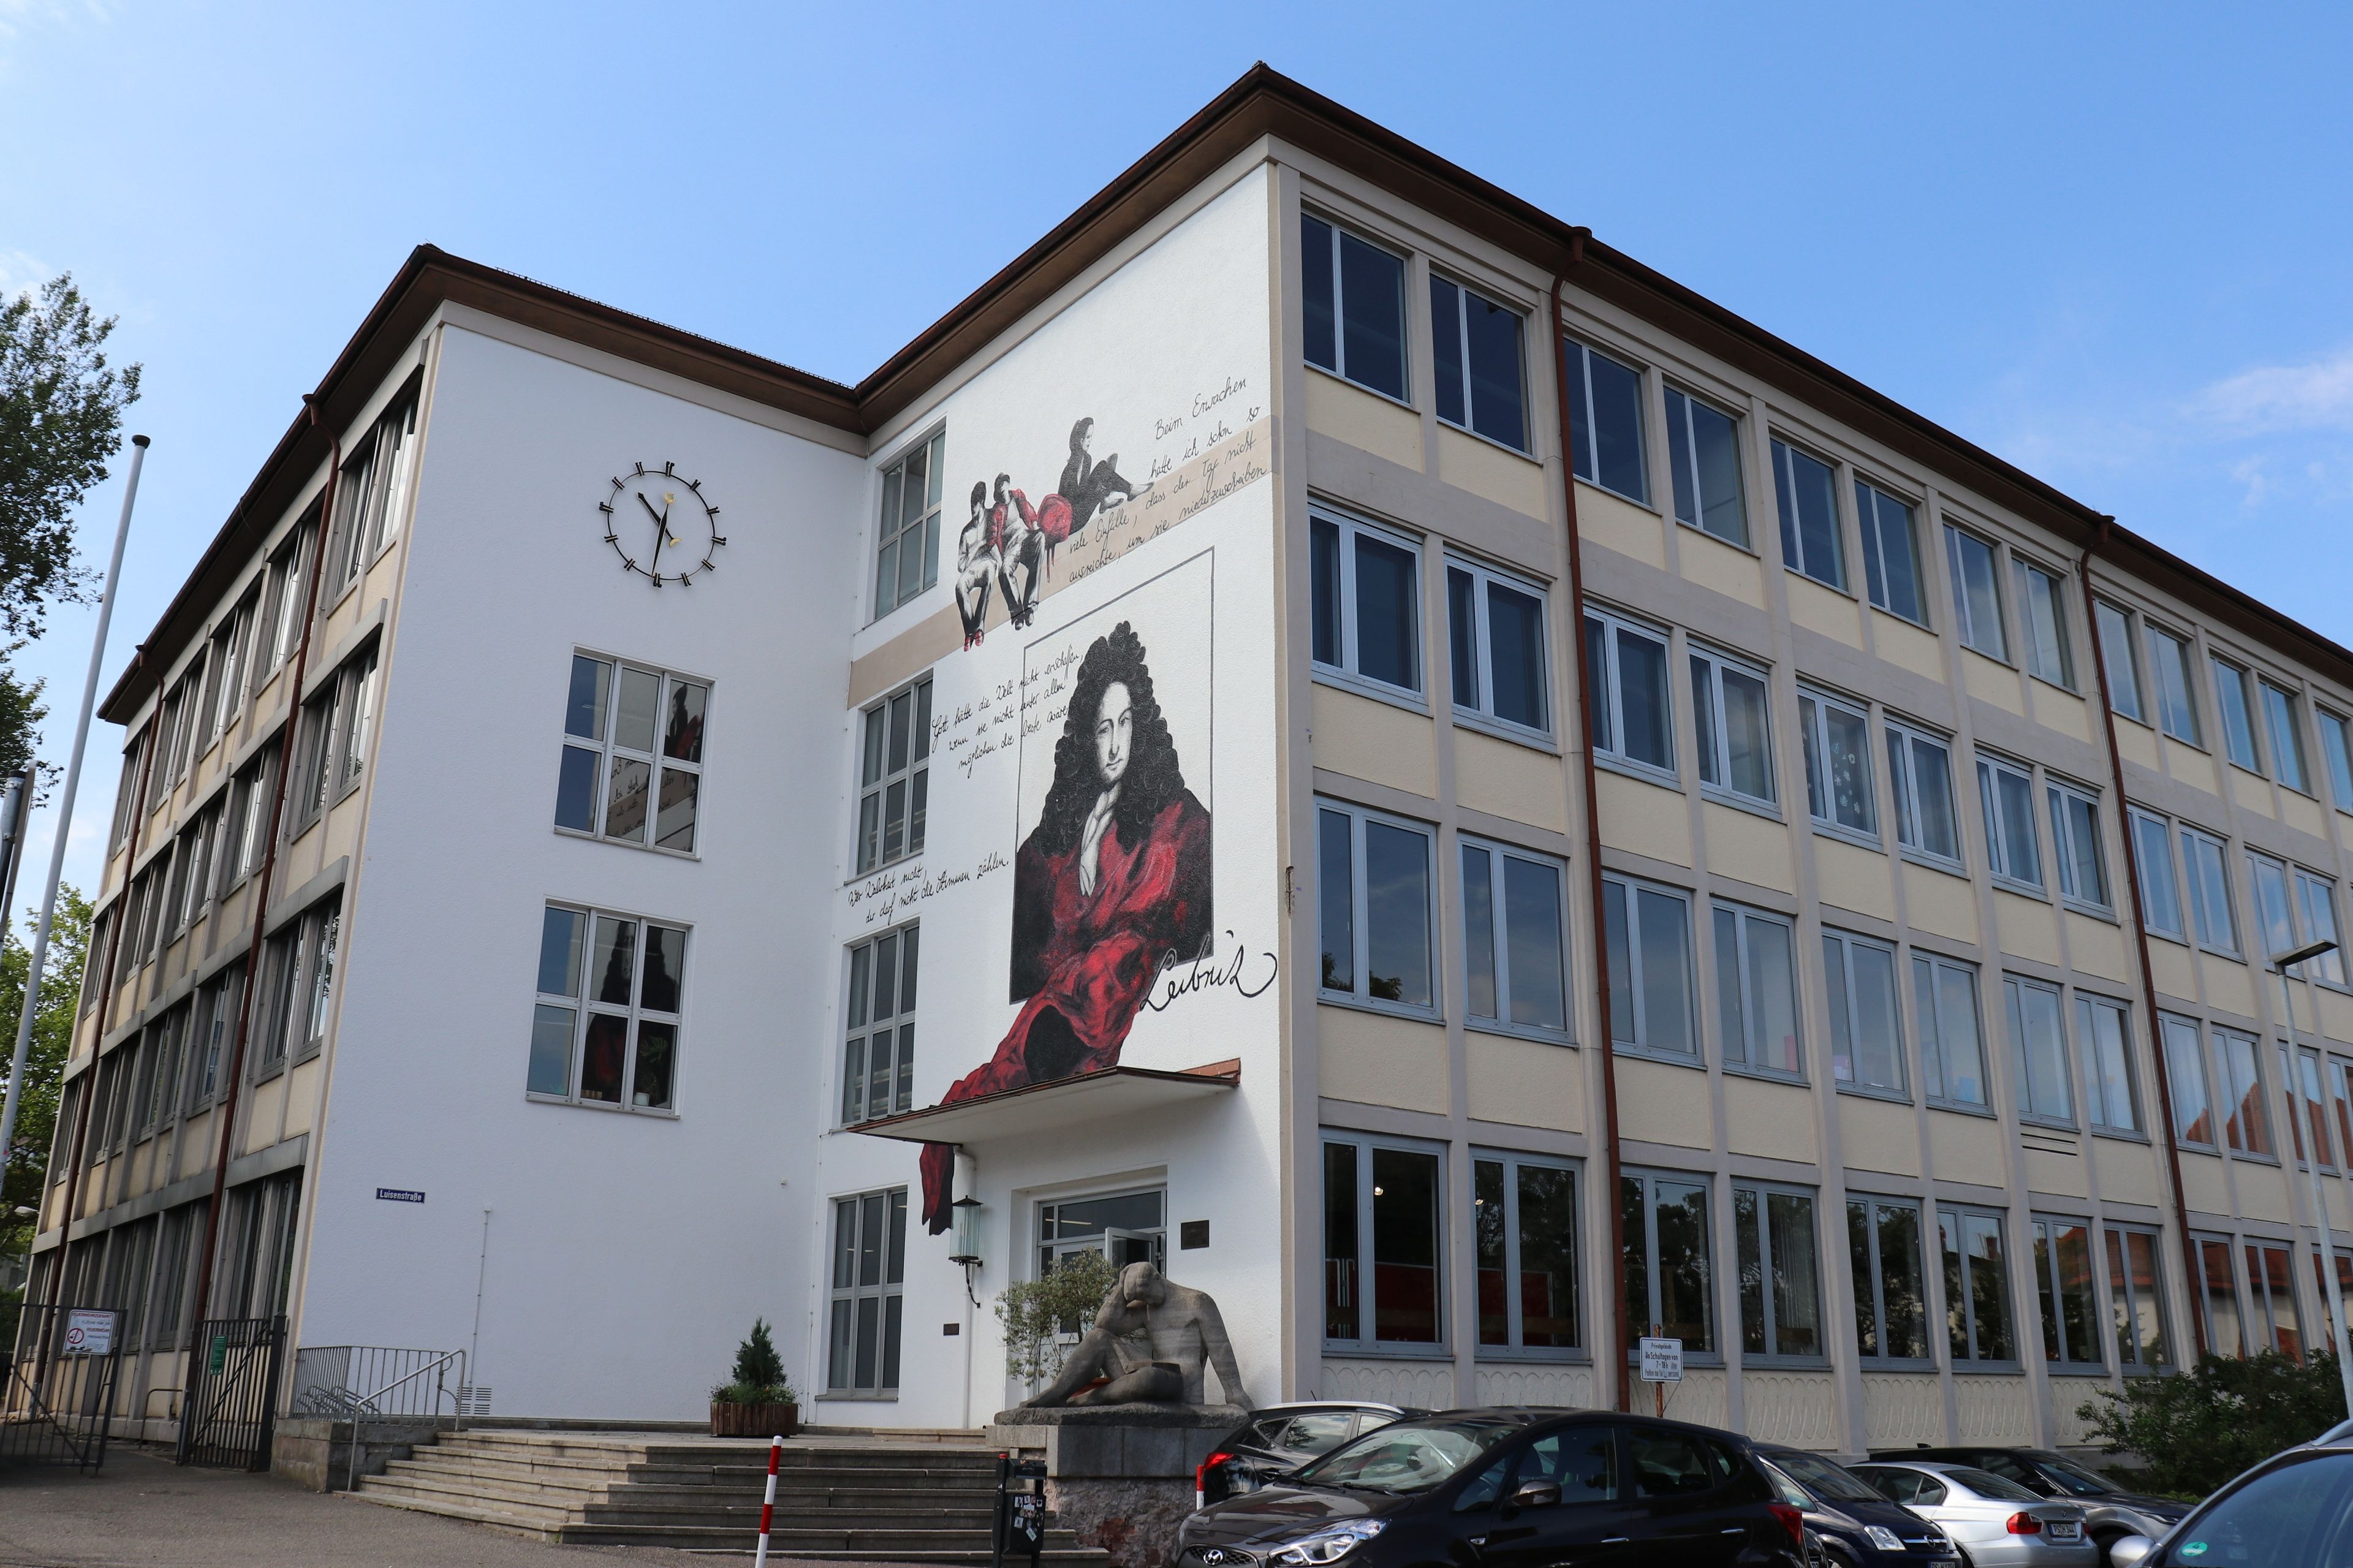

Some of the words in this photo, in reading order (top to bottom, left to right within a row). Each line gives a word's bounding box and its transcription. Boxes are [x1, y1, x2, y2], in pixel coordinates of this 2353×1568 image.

[1154, 417, 1183, 440] Beim
[1192, 376, 1246, 417] Erwachen
[1148, 455, 1172, 480] hatte
[1182, 437, 1199, 461] ich
[1207, 420, 1232, 447] schon
[1246, 406, 1260, 423] so
[1069, 532, 1088, 554] viele
[1146, 490, 1165, 510] dass
[1173, 475, 1191, 493] der
[1203, 458, 1219, 493] Tag
[1224, 430, 1256, 464] nicht
[1126, 536, 1145, 550] um
[1150, 519, 1170, 539] sie
[932, 714, 949, 753] Gott
[979, 696, 990, 711] die
[996, 678, 1013, 700] Welt
[1018, 667, 1040, 689] nicht
[949, 737, 969, 751] wenn
[976, 723, 988, 736] sie
[992, 703, 1014, 725] nicht
[1044, 678, 1066, 699] allen
[958, 741, 998, 779] möglichen
[1001, 733, 1014, 749] die
[848, 890, 862, 907] Wer
[879, 892, 896, 926] darf
[898, 884, 919, 909] nicht
[921, 879, 934, 899] die
[936, 869, 970, 893] Stimmen
[380, 1189, 422, 1202] Luisenstraße
[1650, 1352, 1671, 1361] Schultagen
